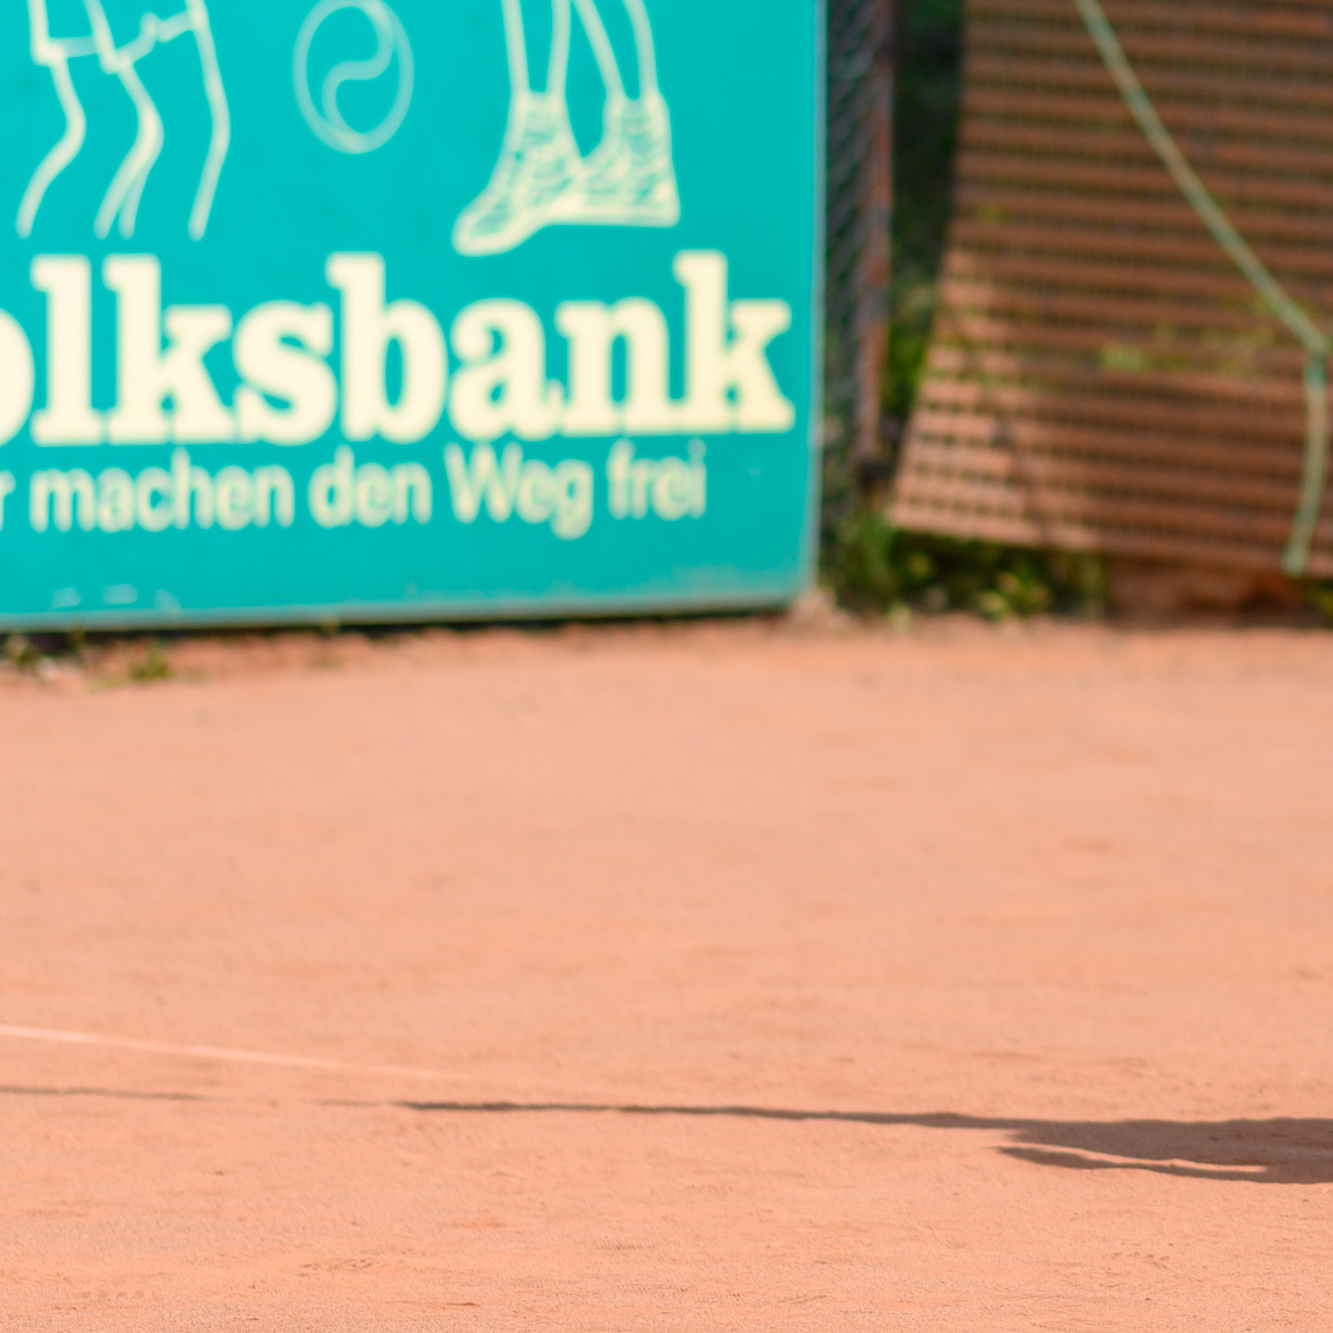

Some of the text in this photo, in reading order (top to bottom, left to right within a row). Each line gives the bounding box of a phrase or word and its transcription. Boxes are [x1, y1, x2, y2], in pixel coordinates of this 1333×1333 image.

[30, 446, 294, 532] machen
[308, 446, 432, 528] den
[444, 441, 594, 540] Weg
[606, 438, 706, 520] frei
